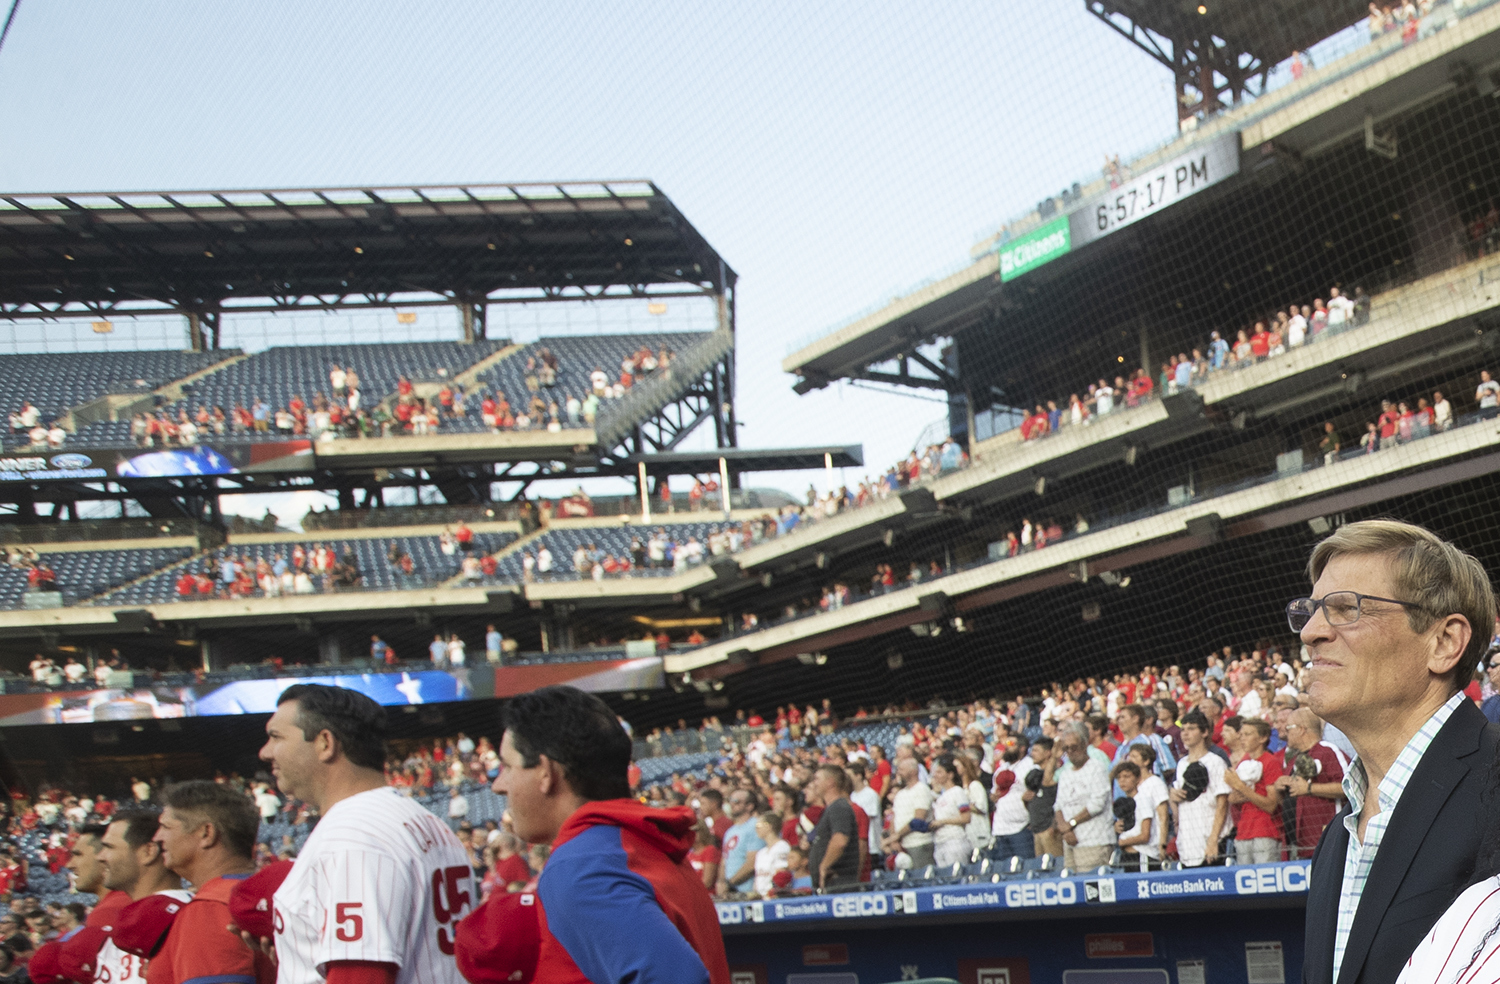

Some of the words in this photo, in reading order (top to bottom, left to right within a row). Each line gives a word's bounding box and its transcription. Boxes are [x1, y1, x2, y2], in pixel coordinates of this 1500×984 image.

[1096, 176, 1166, 231] 6:57:17
[1175, 155, 1208, 194] PM
[1014, 231, 1067, 268] Citizens
[1005, 881, 1076, 907] GEICO
[1150, 880, 1183, 896] Citizens
[1184, 878, 1205, 894] Bank
[1206, 877, 1224, 892] Park
[832, 895, 888, 918] GEICO
[336, 902, 363, 942] 5
[1088, 938, 1125, 955] phillies
